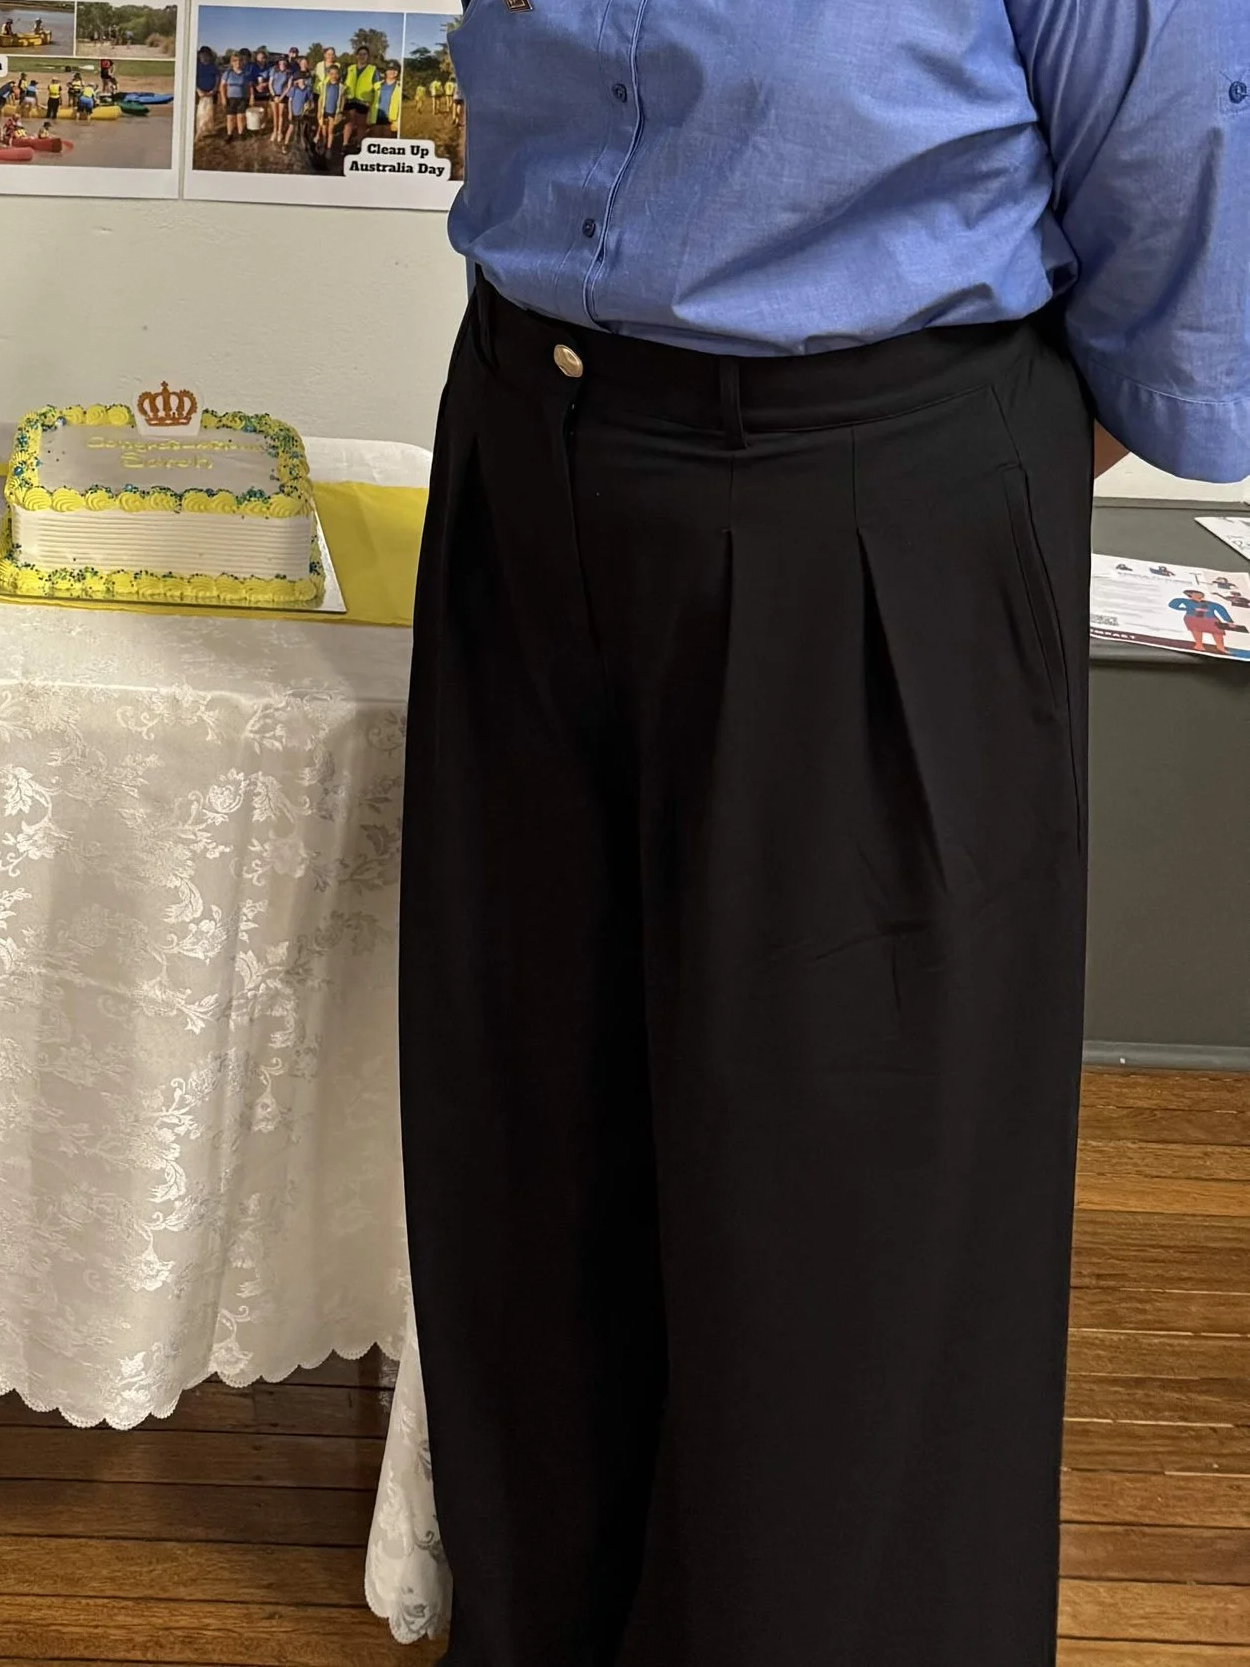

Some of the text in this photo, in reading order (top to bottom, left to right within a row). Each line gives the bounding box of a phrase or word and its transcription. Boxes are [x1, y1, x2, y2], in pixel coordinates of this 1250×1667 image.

[367, 144, 429, 158] Clean Up
[350, 161, 445, 176] Australia Day
